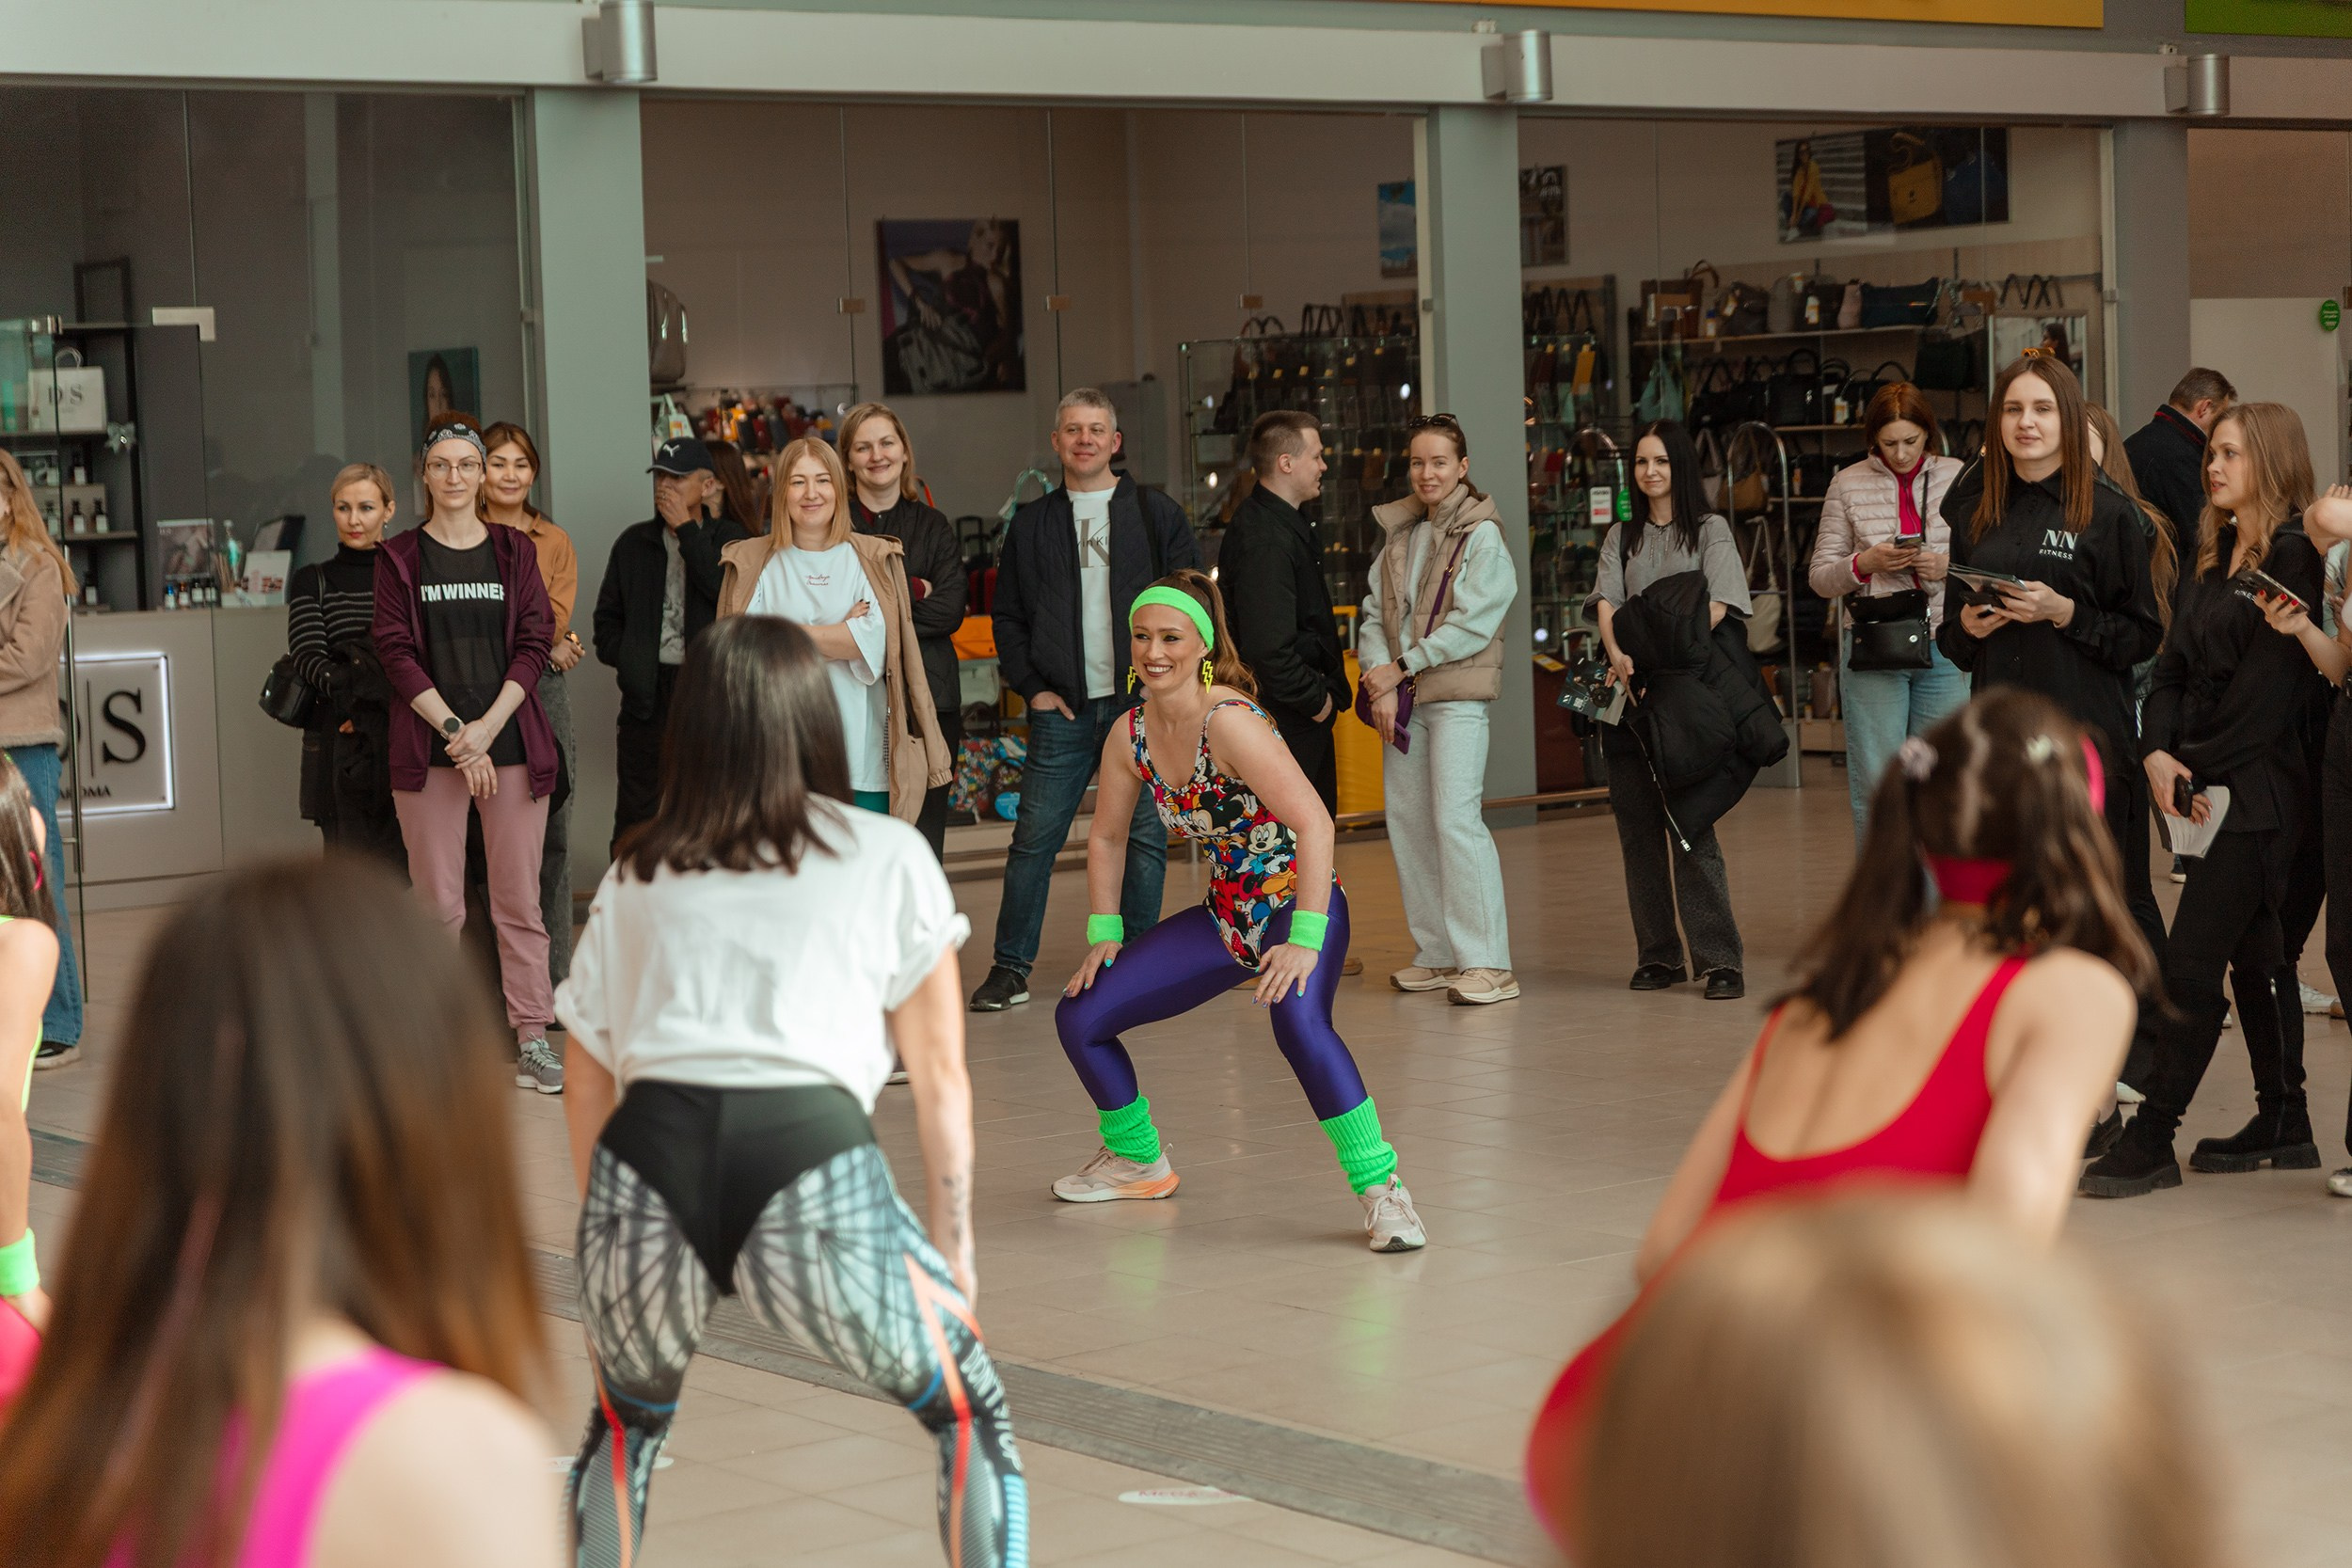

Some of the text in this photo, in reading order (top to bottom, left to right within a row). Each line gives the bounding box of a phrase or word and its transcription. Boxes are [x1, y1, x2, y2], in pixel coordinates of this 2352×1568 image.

[2042, 529, 2078, 550] NN
[2038, 548, 2074, 562] FITNESS
[421, 584, 442, 602] I'M
